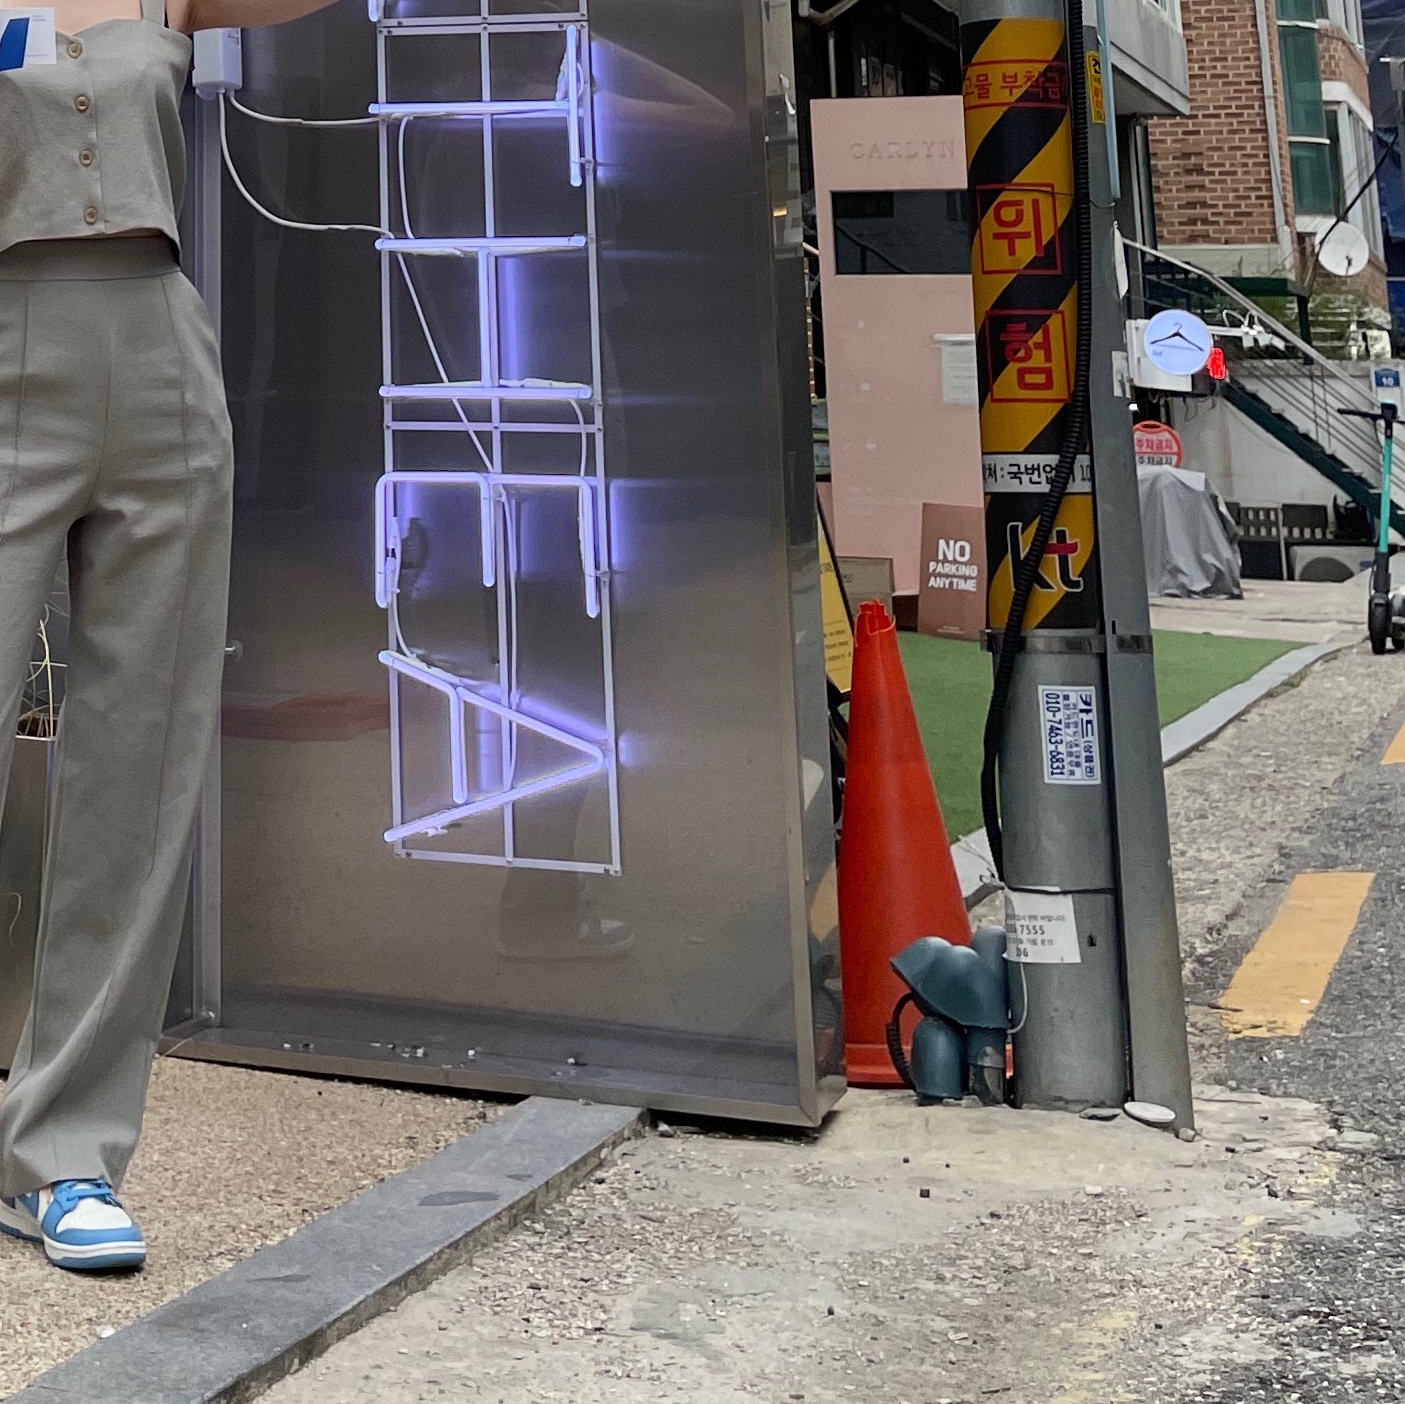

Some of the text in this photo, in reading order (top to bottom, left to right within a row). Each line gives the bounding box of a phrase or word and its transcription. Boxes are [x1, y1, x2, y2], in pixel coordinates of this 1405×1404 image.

[1007, 463, 1075, 486] 국번
[938, 539, 971, 563] NO
[1007, 522, 1084, 592] kt
[928, 561, 978, 578] PARKING
[1045, 692, 1066, 776] 010-7463-6831
